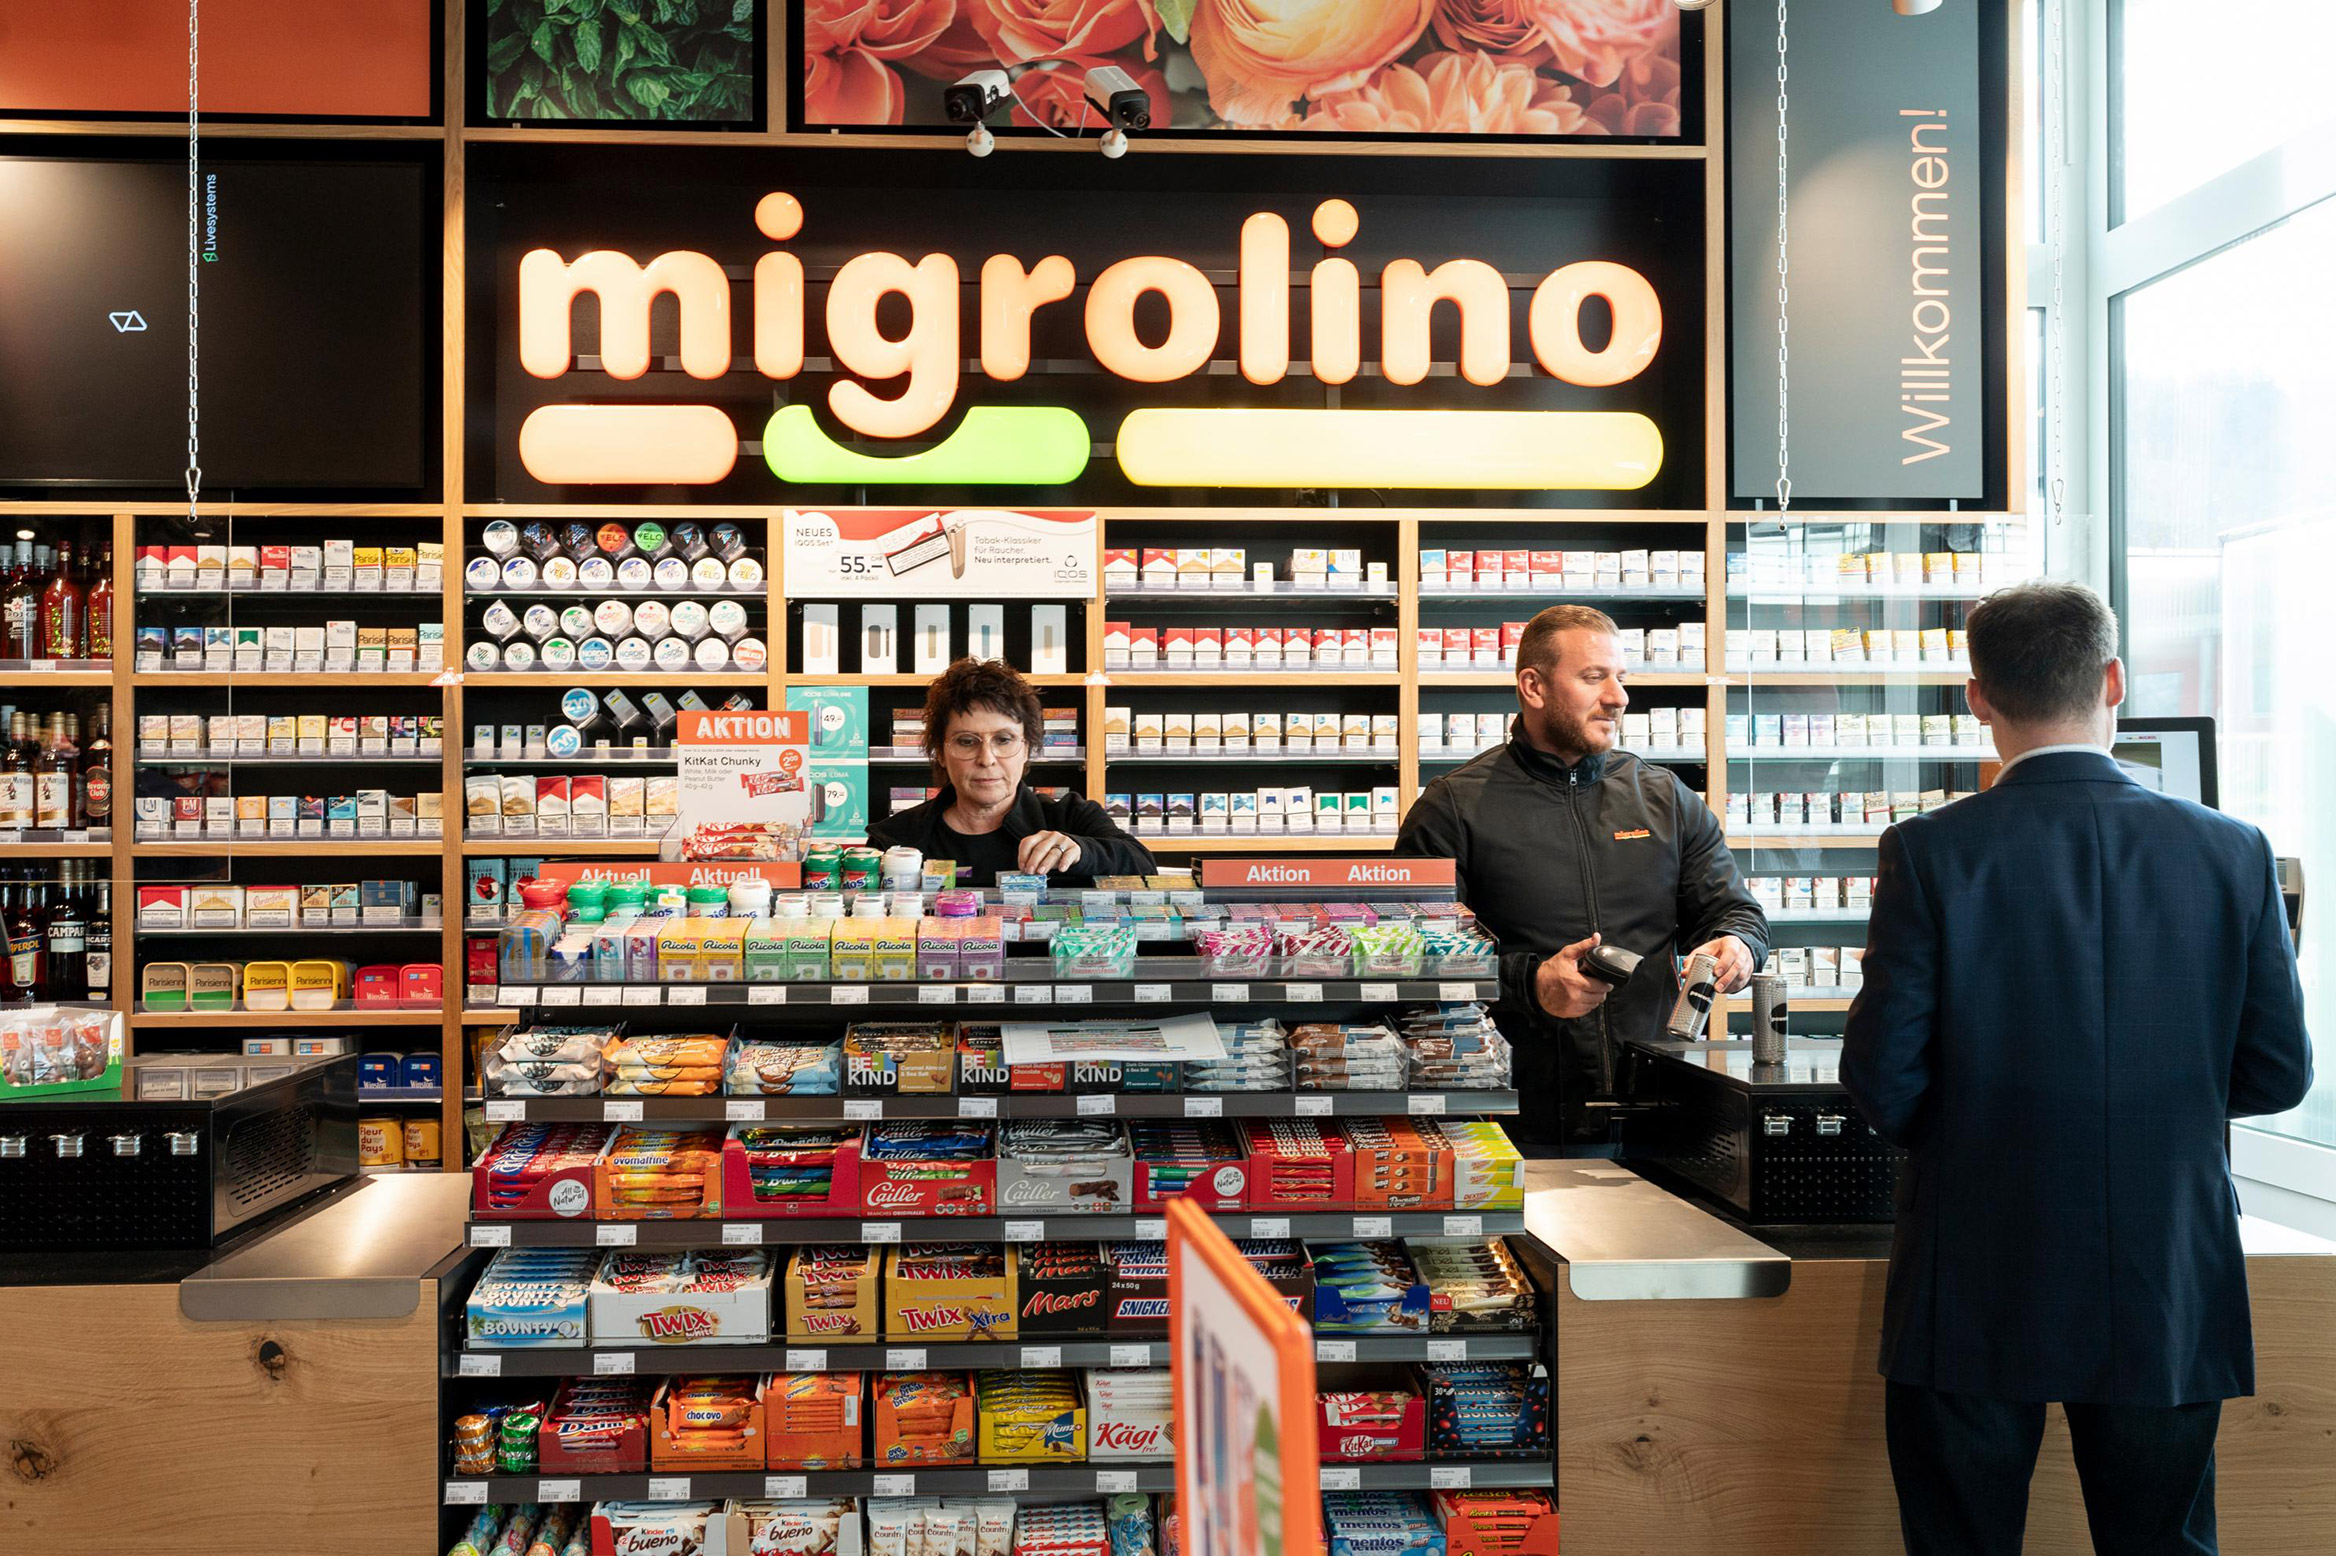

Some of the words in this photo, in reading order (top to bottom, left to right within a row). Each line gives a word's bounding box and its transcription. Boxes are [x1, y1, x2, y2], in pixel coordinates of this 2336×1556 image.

[205, 174, 217, 252] Livesystems
[1899, 108, 1951, 466] Willkommen!
[518, 191, 1663, 439] migrolino
[796, 528, 832, 537] NEUES
[974, 536, 1042, 544] Tabak-Klassiker
[974, 546, 987, 554] für
[989, 546, 1026, 554] Raucher.
[993, 556, 1053, 566] interpretiert.
[1054, 569, 1088, 579] IQOS
[696, 717, 791, 739] AKTION
[684, 757, 718, 766] KitKat
[720, 757, 761, 767] Chunky
[689, 867, 761, 885] Aktuell
[1246, 864, 1310, 882] Aktion
[1347, 864, 1411, 882] Aktion
[661, 940, 697, 950] Ricola
[703, 940, 739, 950] Ricola
[749, 941, 783, 951] Ricola
[790, 940, 826, 950] Ricola
[834, 941, 870, 951] Ricola
[876, 941, 912, 951] Ricola
[920, 940, 956, 950] Ricola
[963, 939, 998, 951] Ricola
[848, 1071, 897, 1085] KIND
[961, 1069, 1009, 1083] KIND
[1074, 1068, 1122, 1083] KIND
[360, 1127, 383, 1136] Fleur
[361, 1136, 373, 1144] du
[360, 1145, 384, 1154] Pays
[613, 1155, 669, 1166] ovomaltine
[1223, 1172, 1234, 1180] All
[1216, 1175, 1243, 1189] Natural
[562, 1186, 573, 1196] All
[866, 1182, 925, 1209] Cailler
[1003, 1180, 1060, 1206] Cailler
[553, 1189, 586, 1207] Natural
[1022, 1289, 1100, 1318] Mars
[1433, 1298, 1450, 1306] NEU
[643, 1307, 712, 1337] Twix
[801, 1312, 851, 1333] Twix
[900, 1303, 964, 1332] Twix
[970, 1312, 1011, 1330] Xtra
[483, 1322, 555, 1335] BOUNTY
[686, 1411, 705, 1420] choc
[705, 1411, 722, 1420] ovo
[557, 1421, 624, 1436] Daim
[1095, 1422, 1160, 1451] Kägi
[888, 1446, 902, 1455] ovo
[1141, 1445, 1159, 1454] fret
[1345, 1437, 1373, 1455] KitKat
[1334, 1507, 1388, 1517] mentos
[781, 1519, 802, 1527] kinder
[1339, 1521, 1402, 1530] mentos
[641, 1527, 666, 1536] kinder
[769, 1526, 813, 1541] bueno
[874, 1530, 904, 1540] Country
[926, 1528, 957, 1538] Country
[980, 1525, 1010, 1535] Country
[627, 1535, 679, 1553] bueno
